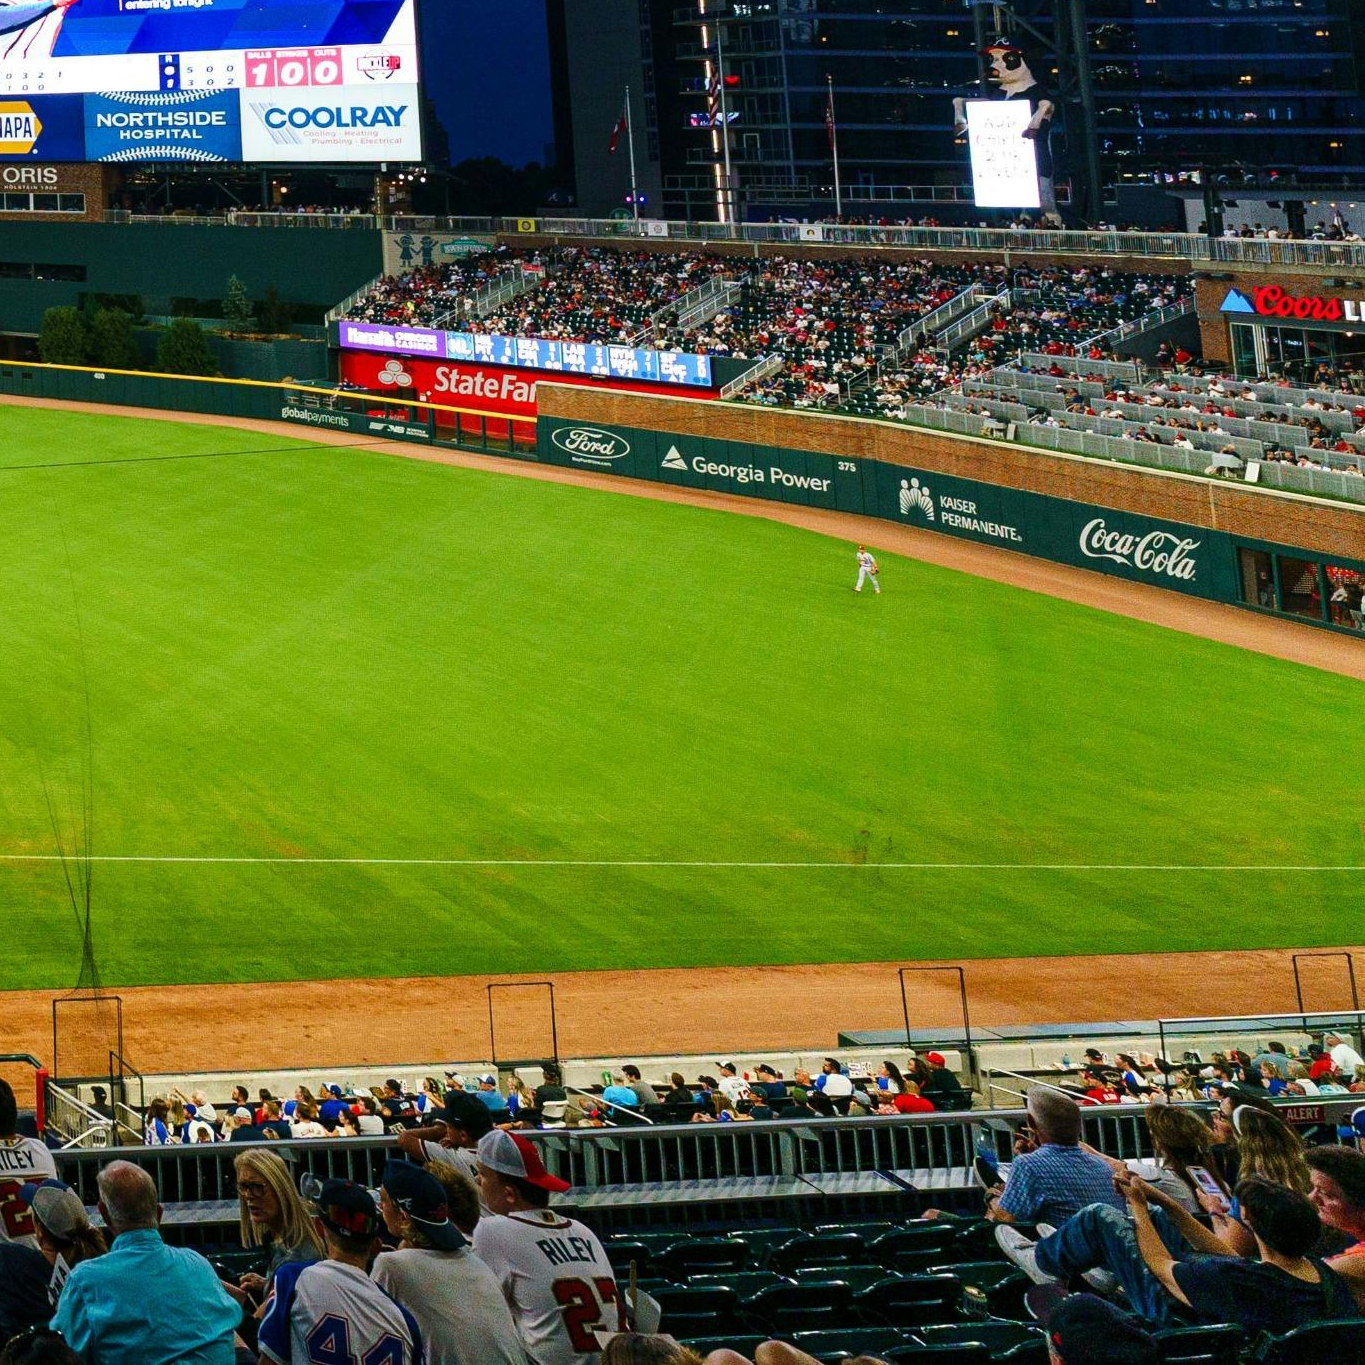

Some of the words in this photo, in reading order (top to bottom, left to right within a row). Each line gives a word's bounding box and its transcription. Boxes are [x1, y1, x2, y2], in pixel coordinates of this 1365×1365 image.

[252, 63, 268, 86] 1
[280, 62, 304, 85] 0
[313, 60, 338, 84] 0
[96, 110, 226, 128] NORTHSIDE
[265, 105, 409, 129] COOLRAY
[119, 129, 202, 140] HOSPITAL
[303, 130, 336, 139] Cooling
[344, 129, 379, 137] Heating
[311, 137, 353, 146] Plumbing
[3, 167, 58, 184] ORIS
[1253, 284, 1343, 321] Coors
[281, 406, 349, 427] globalpayments
[565, 430, 615, 456] Ford
[692, 456, 765, 483] Georgia
[770, 467, 831, 492] Power
[837, 461, 857, 473] 375
[940, 495, 977, 515] KAISER
[941, 511, 1017, 542] PERMANENTE
[1080, 518, 1202, 581] Coca-Cola
[1286, 1105, 1319, 1120] ALERT
[536, 1237, 599, 1267] RILEY
[550, 1275, 630, 1354] 27
